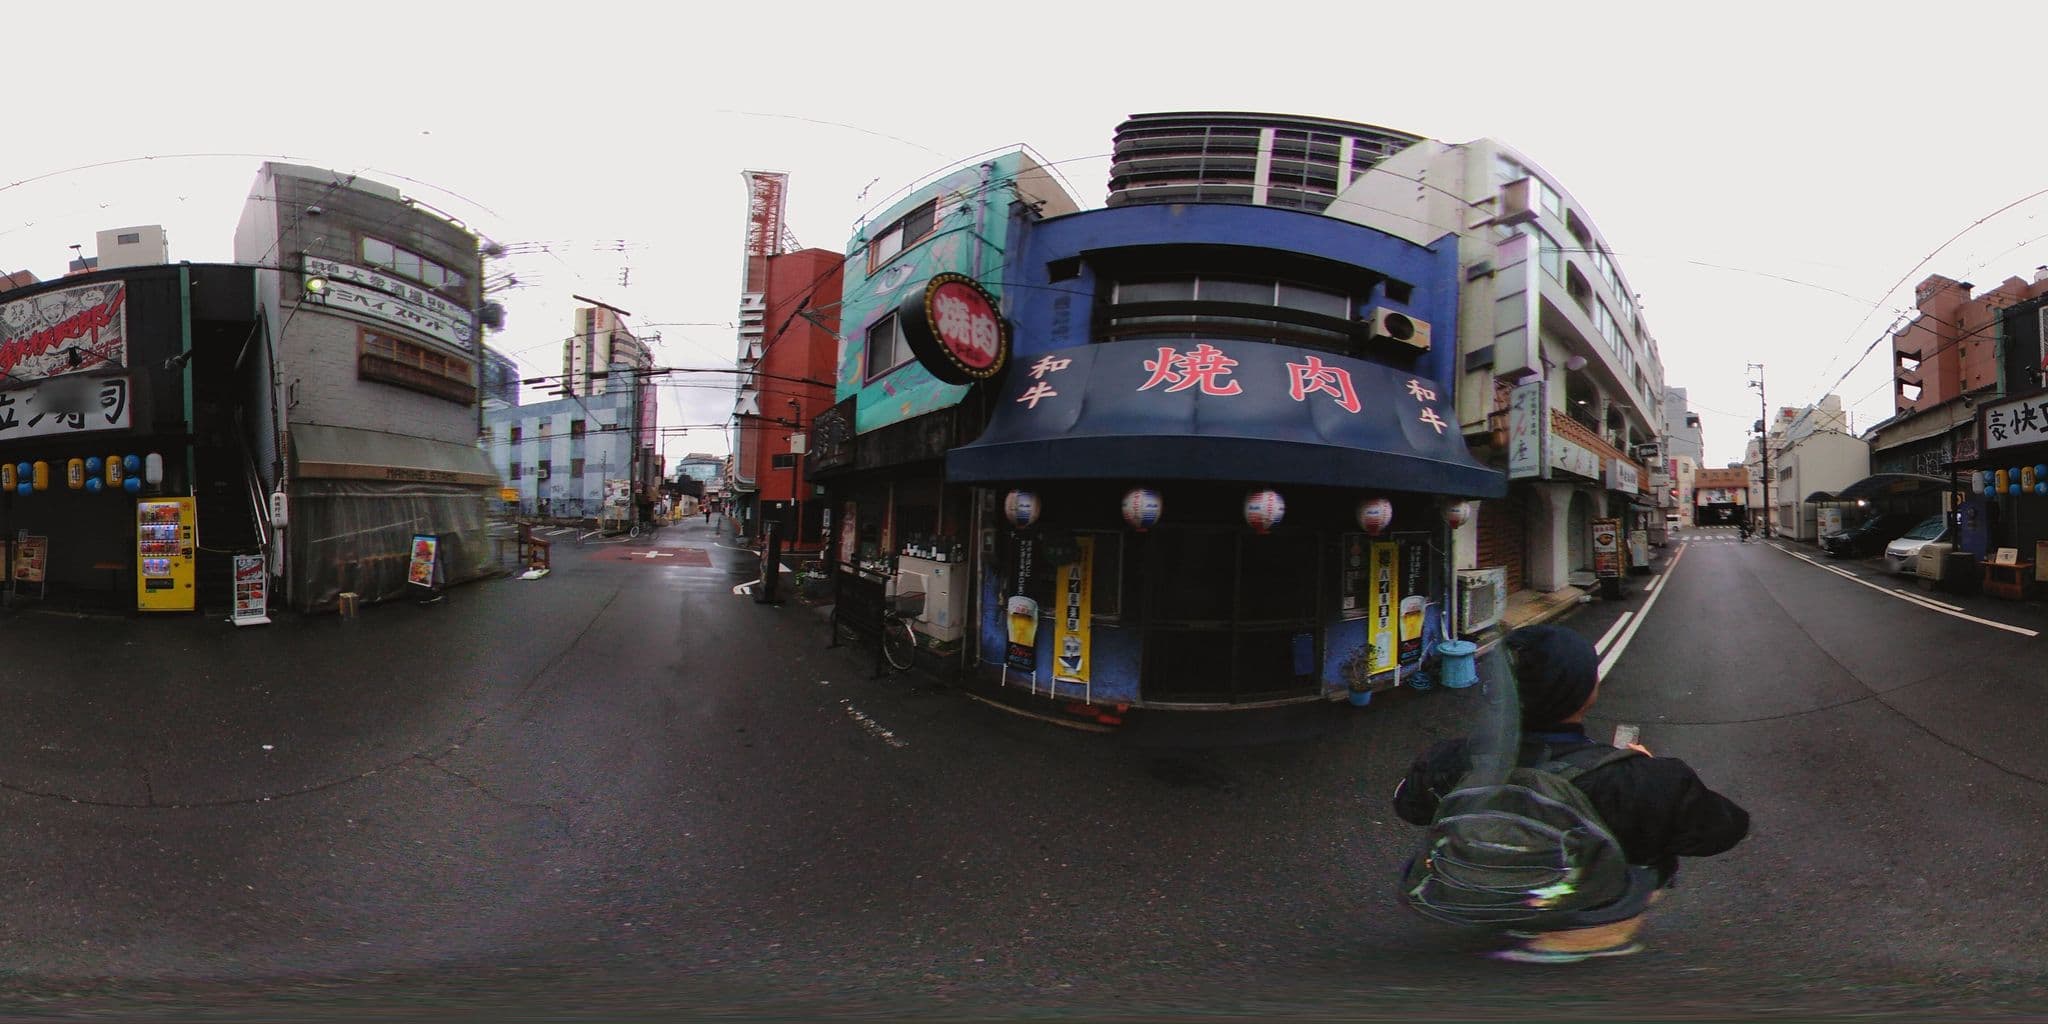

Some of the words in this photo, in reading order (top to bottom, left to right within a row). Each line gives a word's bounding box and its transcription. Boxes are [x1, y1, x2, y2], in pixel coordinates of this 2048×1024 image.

[936, 294, 999, 358] 焼肉
[1017, 354, 1073, 409] 和牛
[1137, 343, 1362, 413] 焼肉
[1406, 378, 1448, 434] 和牛
